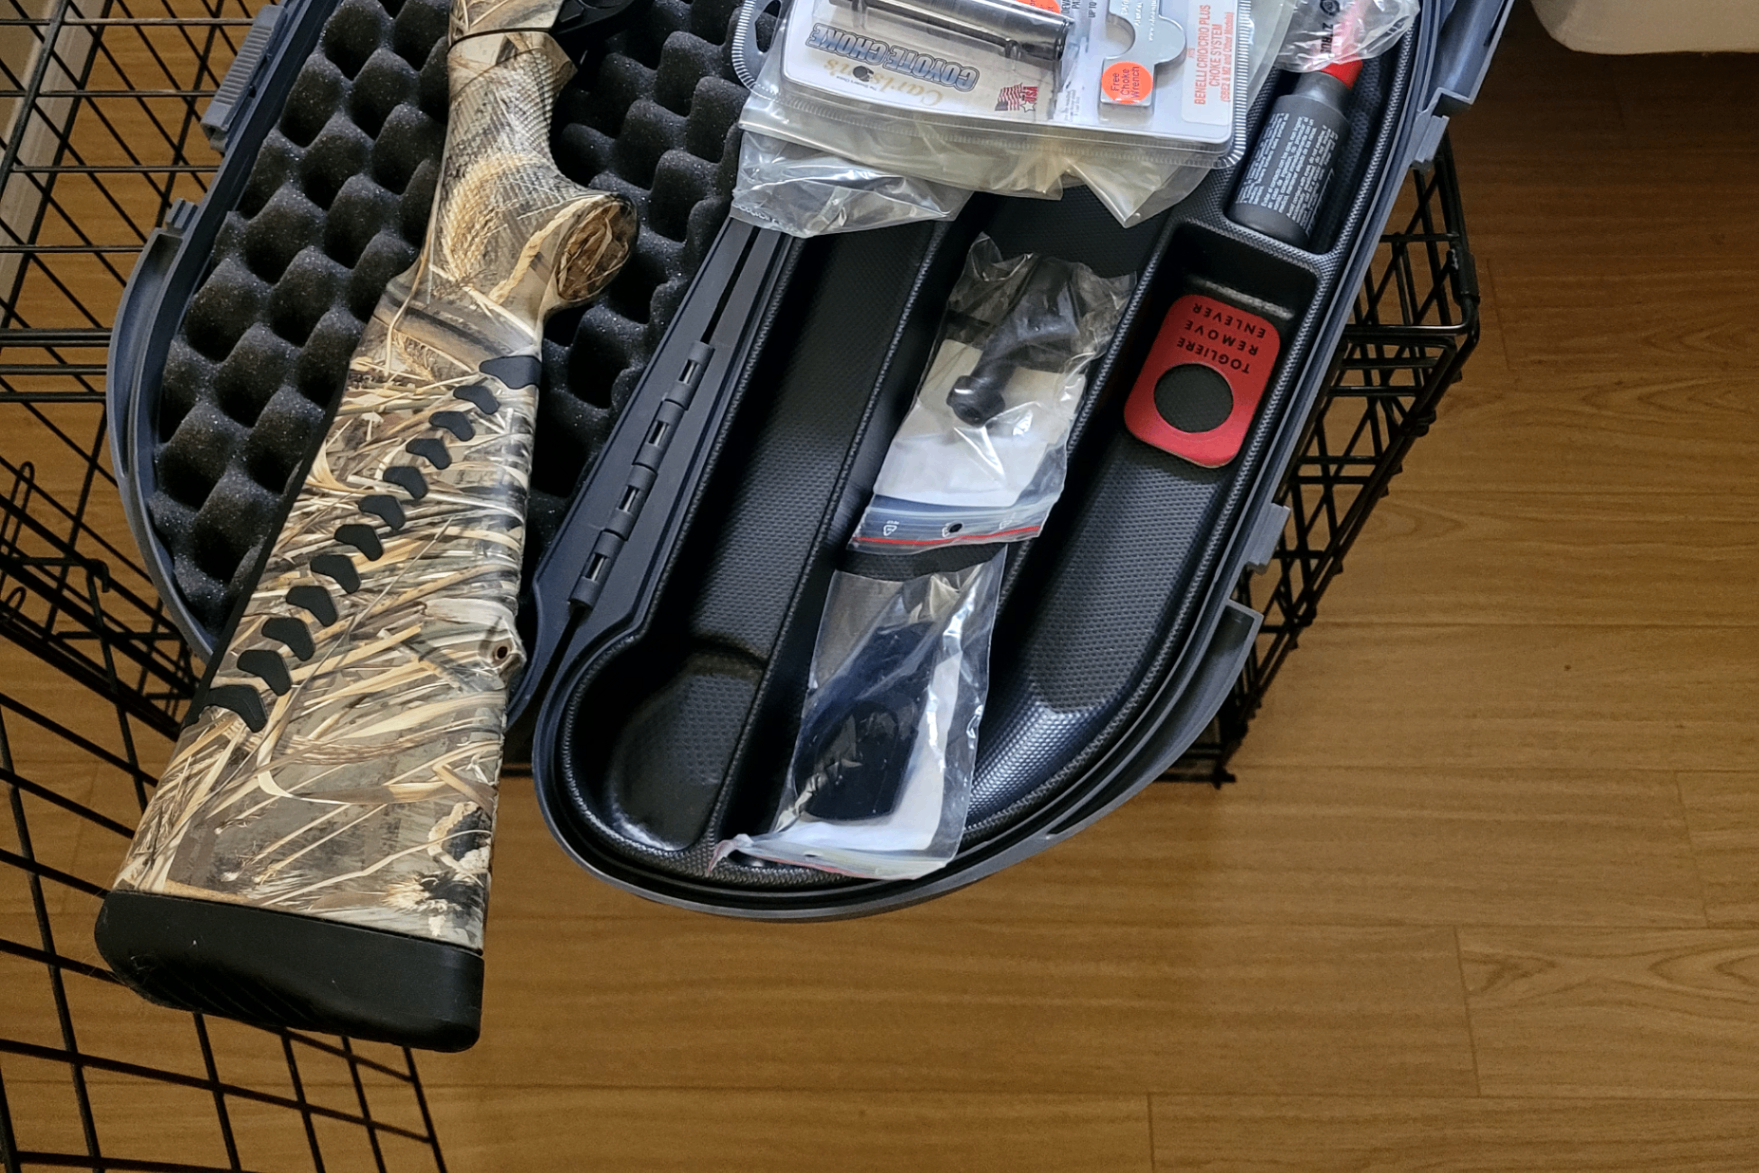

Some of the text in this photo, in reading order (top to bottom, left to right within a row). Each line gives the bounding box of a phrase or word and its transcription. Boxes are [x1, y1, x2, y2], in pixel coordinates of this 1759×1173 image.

[805, 23, 980, 92] COYOTE CHOKE
[1194, 5, 1211, 105] BENELLI CRIO/CRIO PLUS
[1209, 24, 1222, 87] CHOKE SYSTEM
[1111, 73, 1120, 92] Free
[1121, 69, 1130, 96] Choke
[1130, 66, 1140, 98] Wrench
[1185, 320, 1259, 356] REMOVE
[1193, 303, 1266, 338] ENLEVER
[1177, 337, 1250, 374] TOGLIERE
